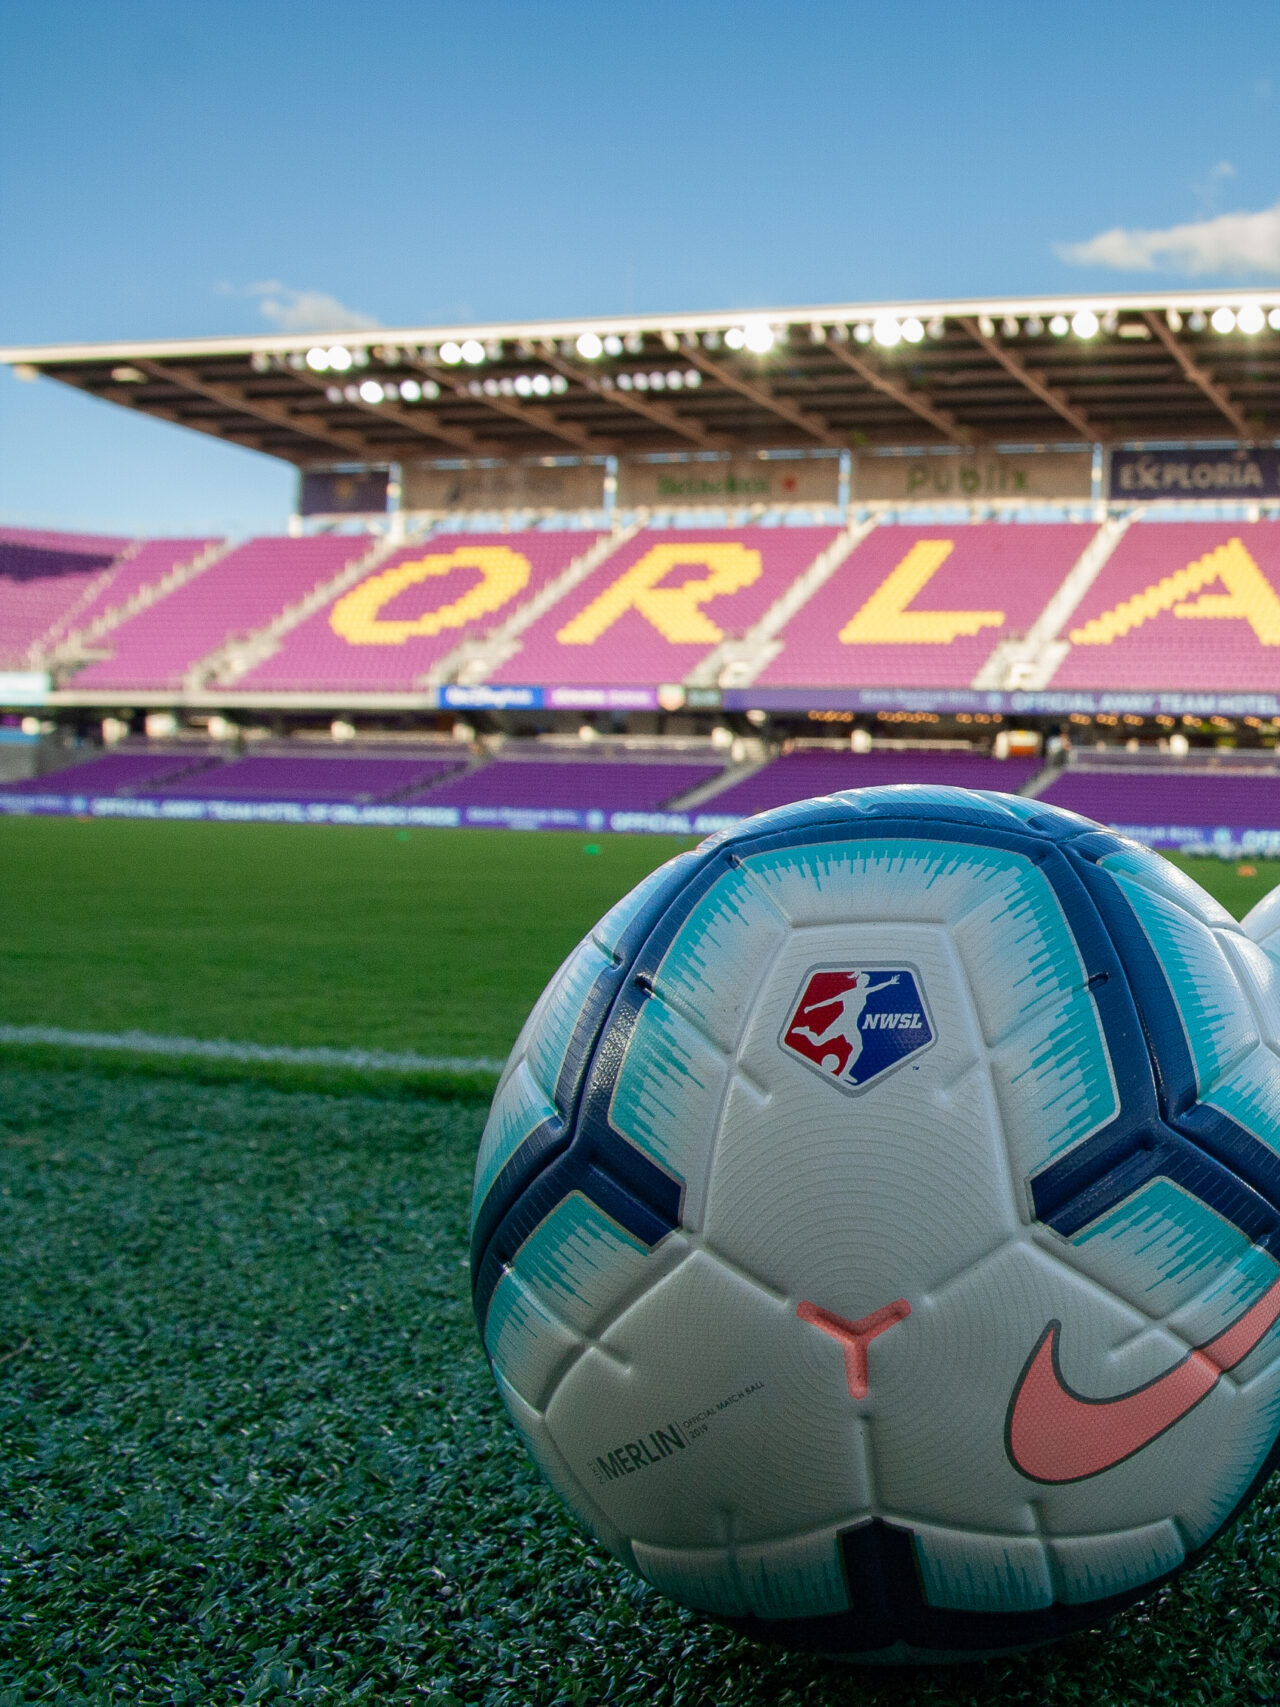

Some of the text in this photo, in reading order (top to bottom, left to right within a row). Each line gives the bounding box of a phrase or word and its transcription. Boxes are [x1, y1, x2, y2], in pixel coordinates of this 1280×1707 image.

[1118, 455, 1263, 490] EXPLORIA
[1010, 691, 1098, 713] OFFICIAL
[1099, 692, 1155, 713] AWAY
[1158, 692, 1213, 714] TEAM
[1215, 693, 1280, 715] HOTEL
[610, 812, 692, 833] OFFICIAL
[861, 1013, 923, 1030] NWSL
[682, 1380, 765, 1429] OFFICIAL MATCH BALL
[688, 1423, 709, 1440] 2019
[595, 1423, 687, 1481] MERLIN
